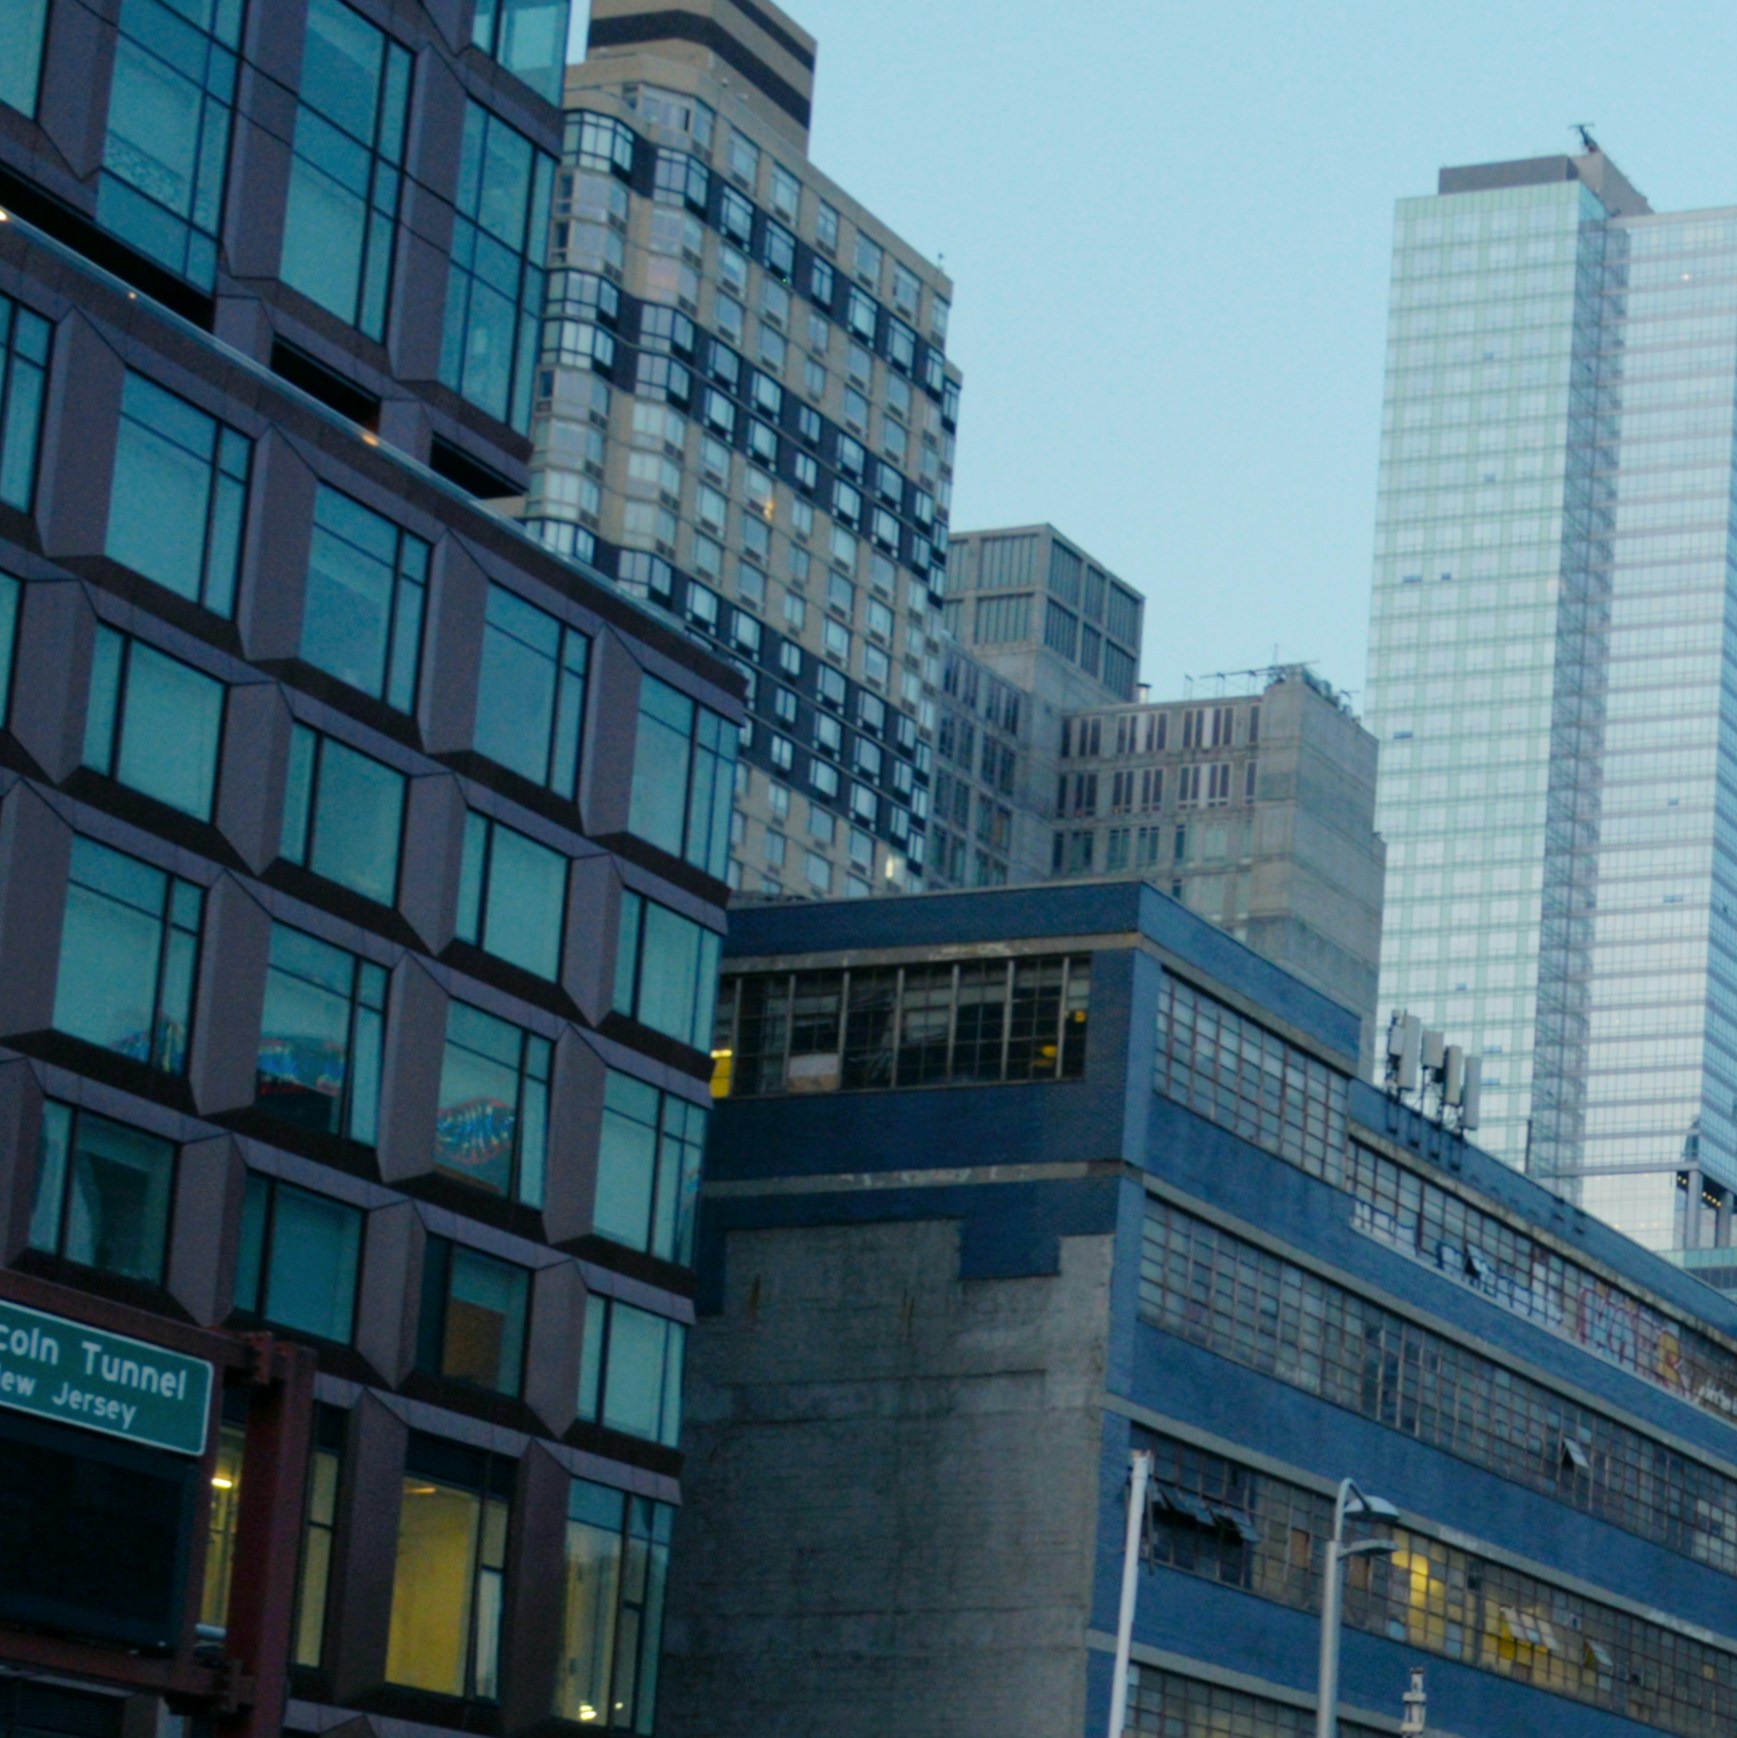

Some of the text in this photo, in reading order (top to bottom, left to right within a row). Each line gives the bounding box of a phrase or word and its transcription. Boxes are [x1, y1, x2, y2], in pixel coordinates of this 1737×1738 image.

[0, 1370, 137, 1431] ew Jersey
[81, 1339, 188, 1401] Tunnel
